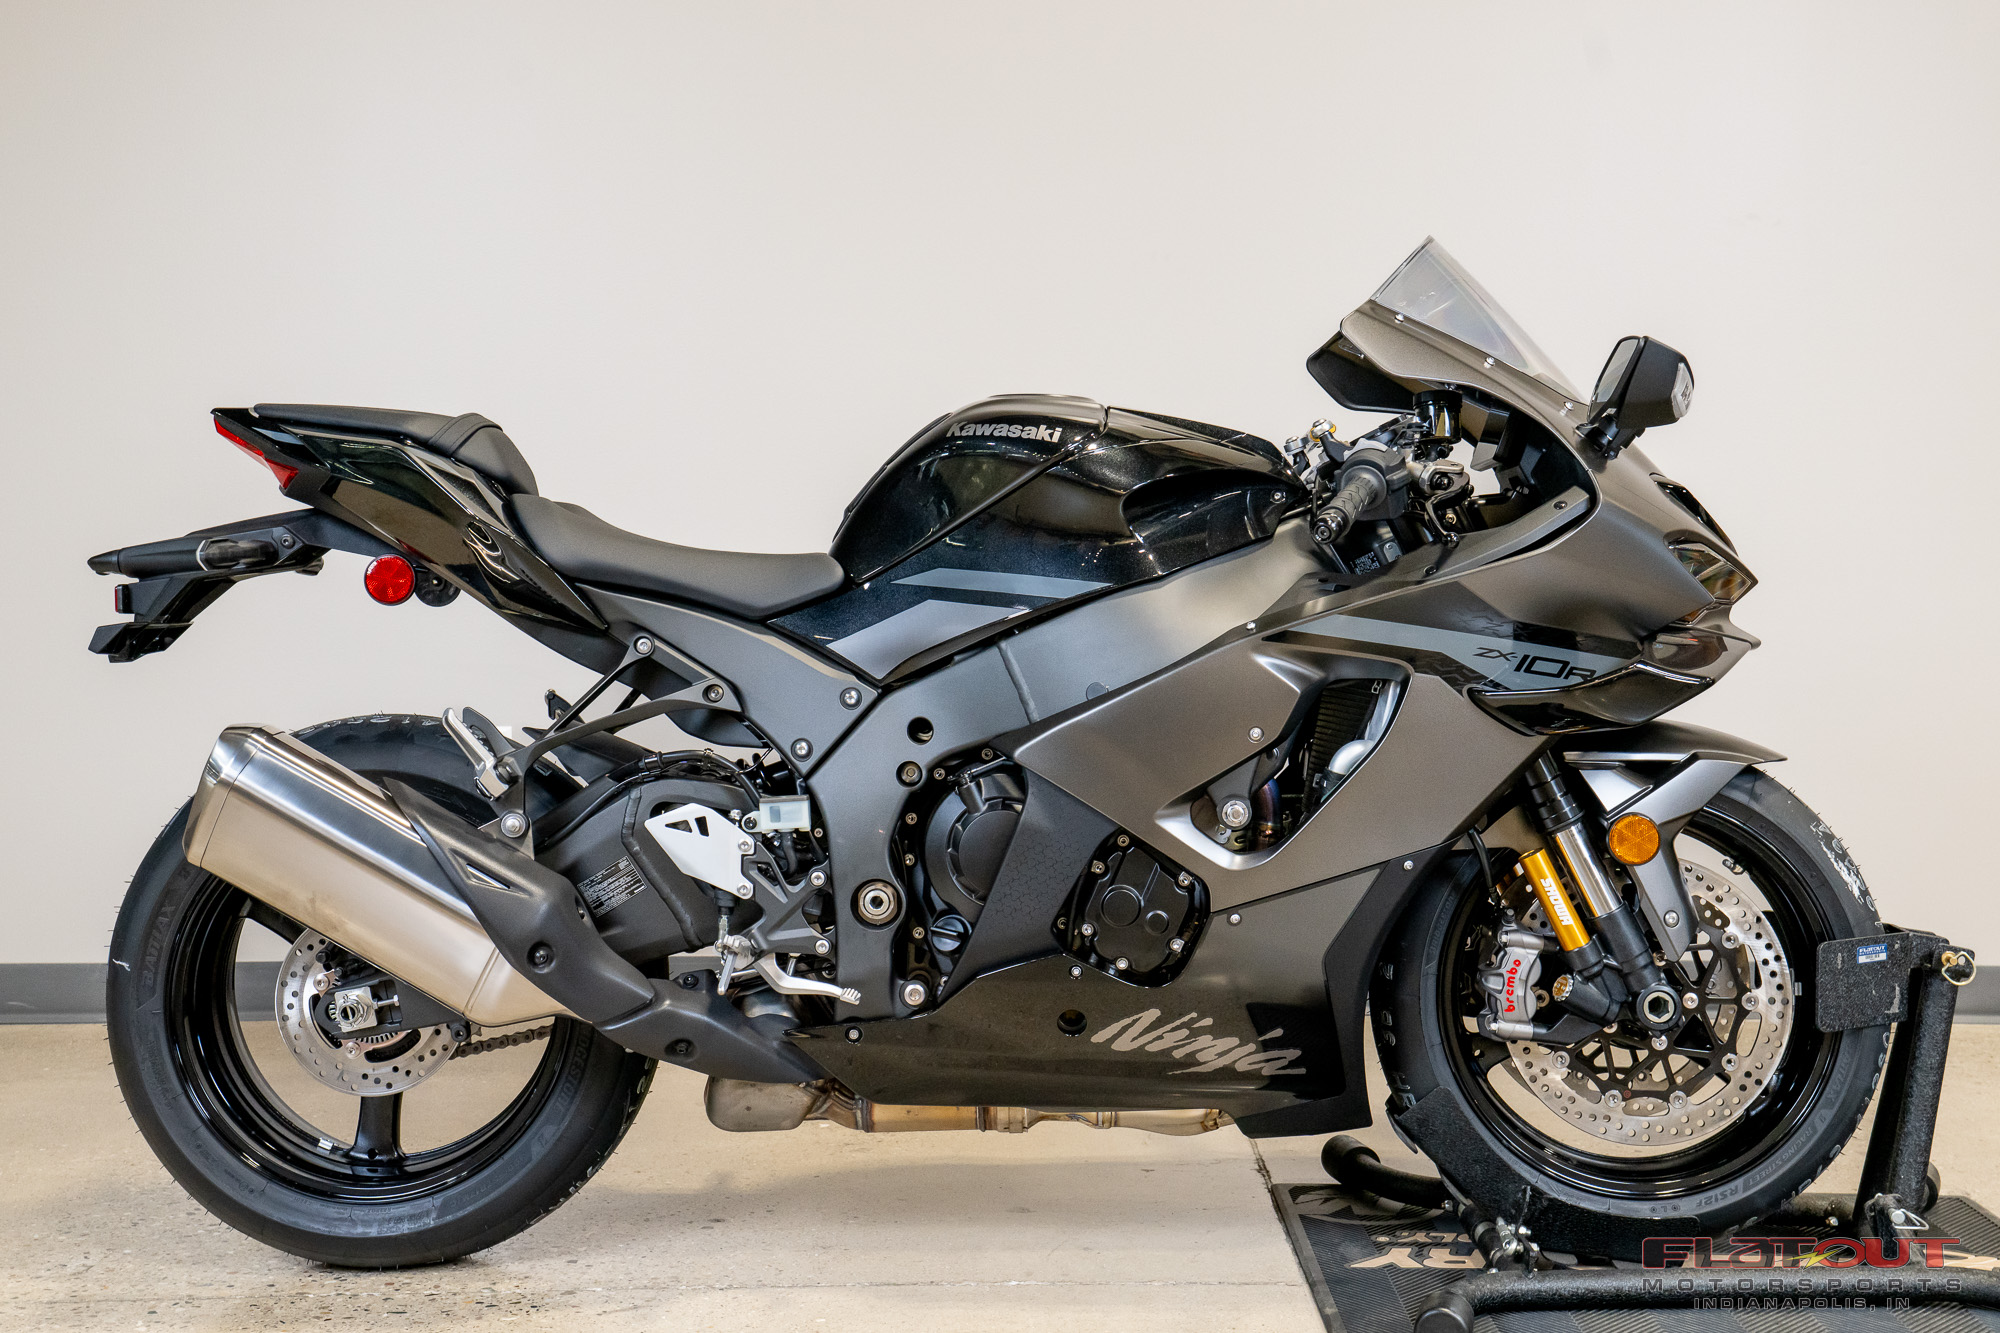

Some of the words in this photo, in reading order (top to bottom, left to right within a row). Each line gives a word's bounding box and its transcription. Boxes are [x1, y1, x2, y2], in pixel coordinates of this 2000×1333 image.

[946, 421, 1062, 443] Kawasaki
[1472, 647, 1597, 681] ZX-10R
[1540, 877, 1573, 926] SHOWA
[1504, 958, 1521, 1013] brembo
[1090, 1008, 1306, 1076] Ninja
